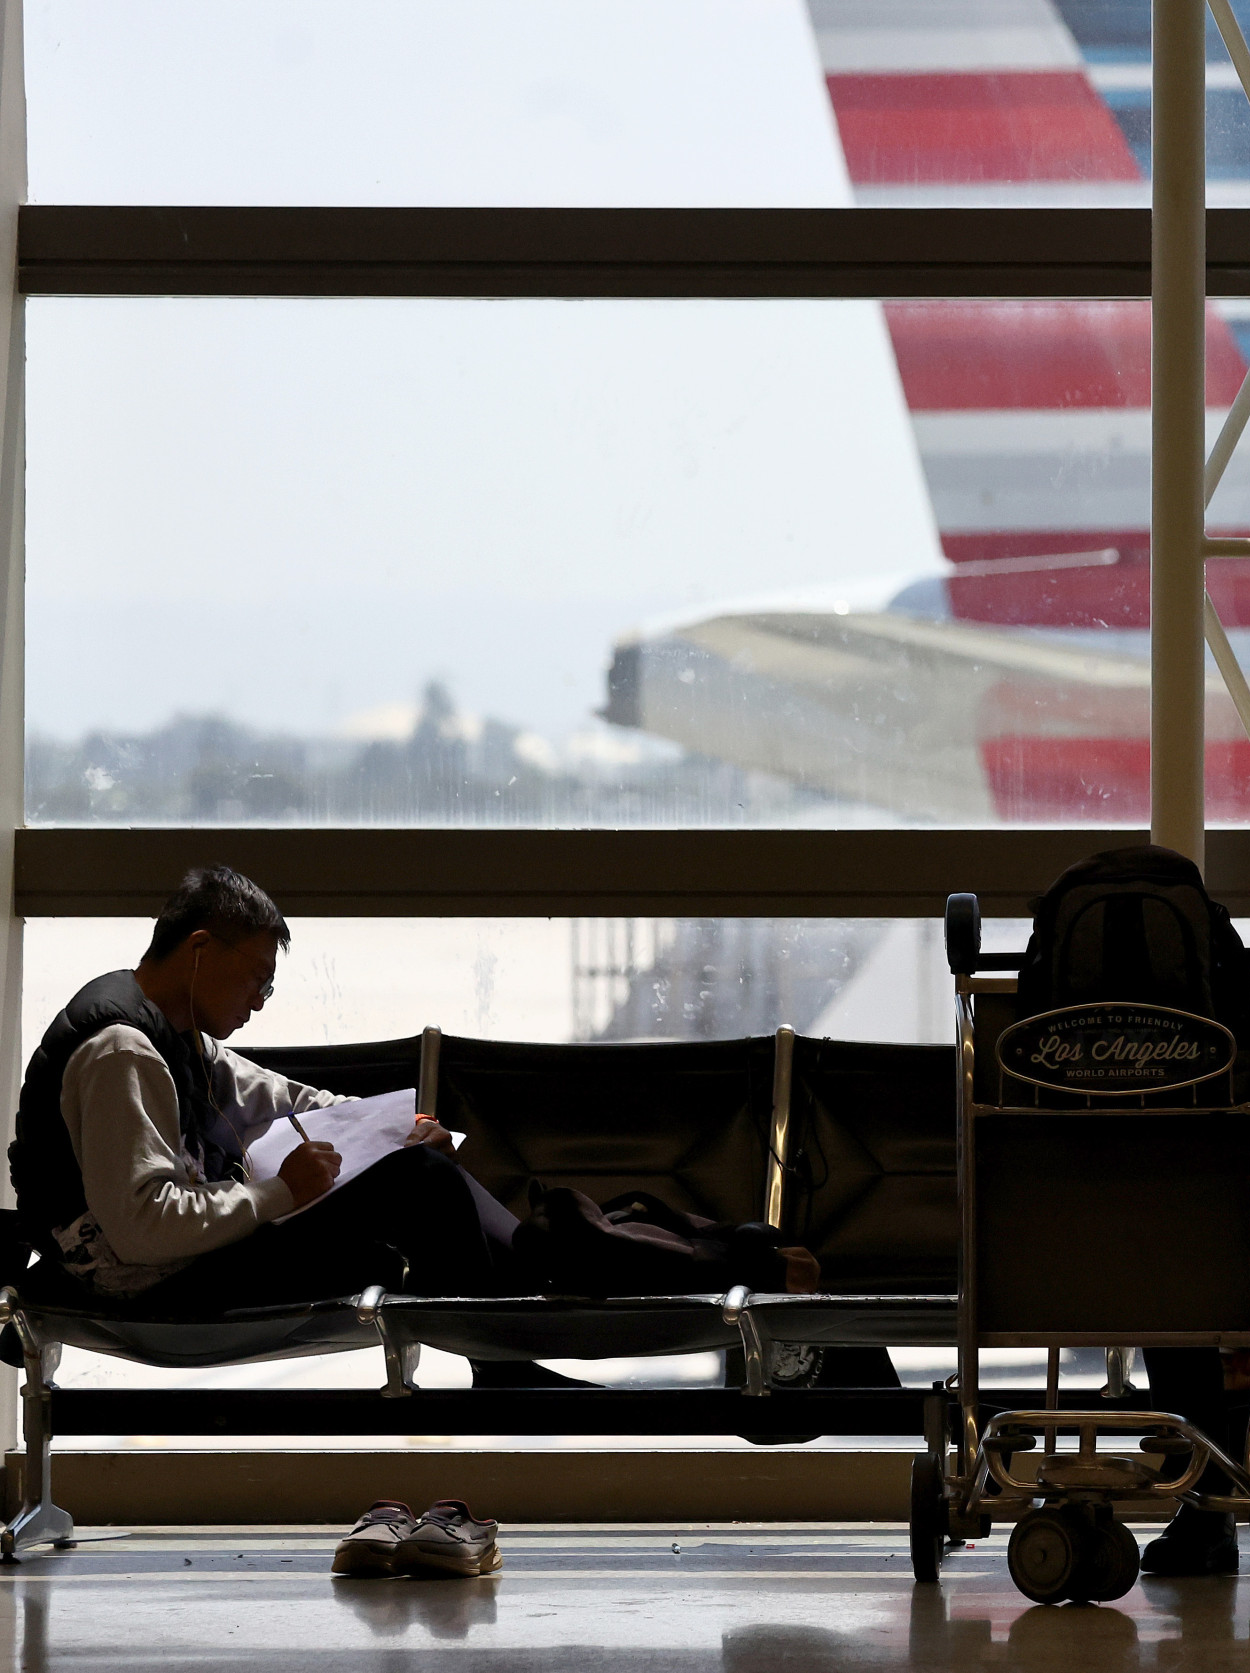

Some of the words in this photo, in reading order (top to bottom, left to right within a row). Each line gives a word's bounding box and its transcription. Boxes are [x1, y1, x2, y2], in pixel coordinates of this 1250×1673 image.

[1048, 1016, 1102, 1033] WELCOME
[1107, 1015, 1122, 1023] TO
[1127, 1016, 1184, 1031] FRIENDLY
[1030, 1035, 1084, 1069] Los
[1092, 1035, 1201, 1068] Angeles
[1066, 1069, 1105, 1077] WORLD
[1108, 1068, 1165, 1076] AIRPORTS
